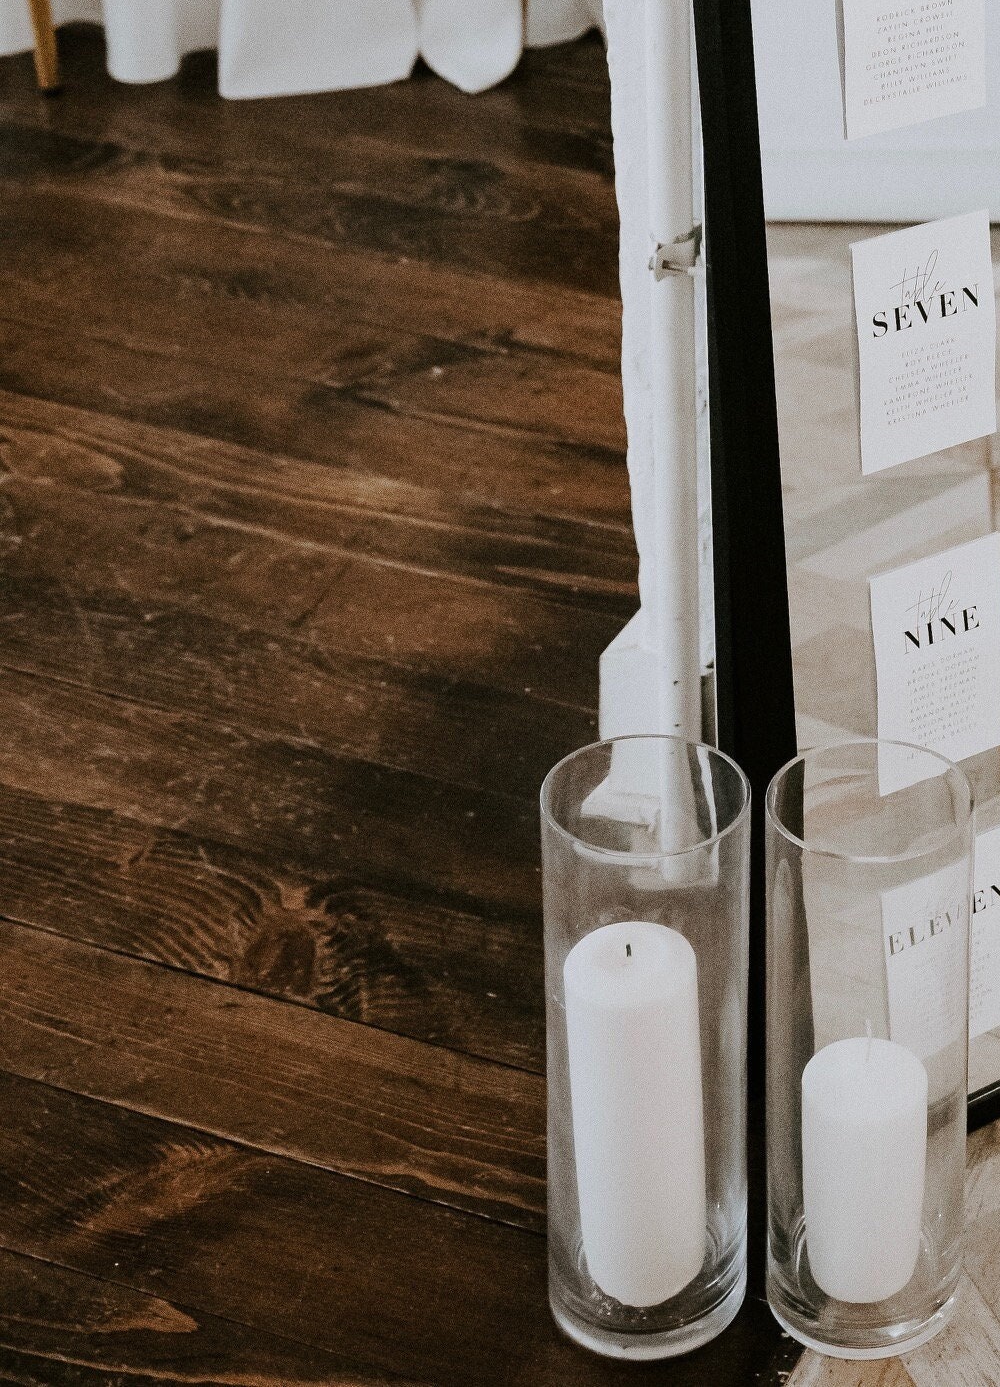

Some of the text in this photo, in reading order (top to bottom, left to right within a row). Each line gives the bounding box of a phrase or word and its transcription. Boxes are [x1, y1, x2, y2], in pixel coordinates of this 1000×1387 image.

[865, 40, 965, 72] GEORGE RICHARDSON
[871, 31, 959, 59] DEON RICHARDSON
[909, 67, 950, 83] WILLIAMS
[926, 74, 968, 91] WILLIAMS
[872, 284, 979, 338] SEVEN
[904, 605, 980, 655] NINE
